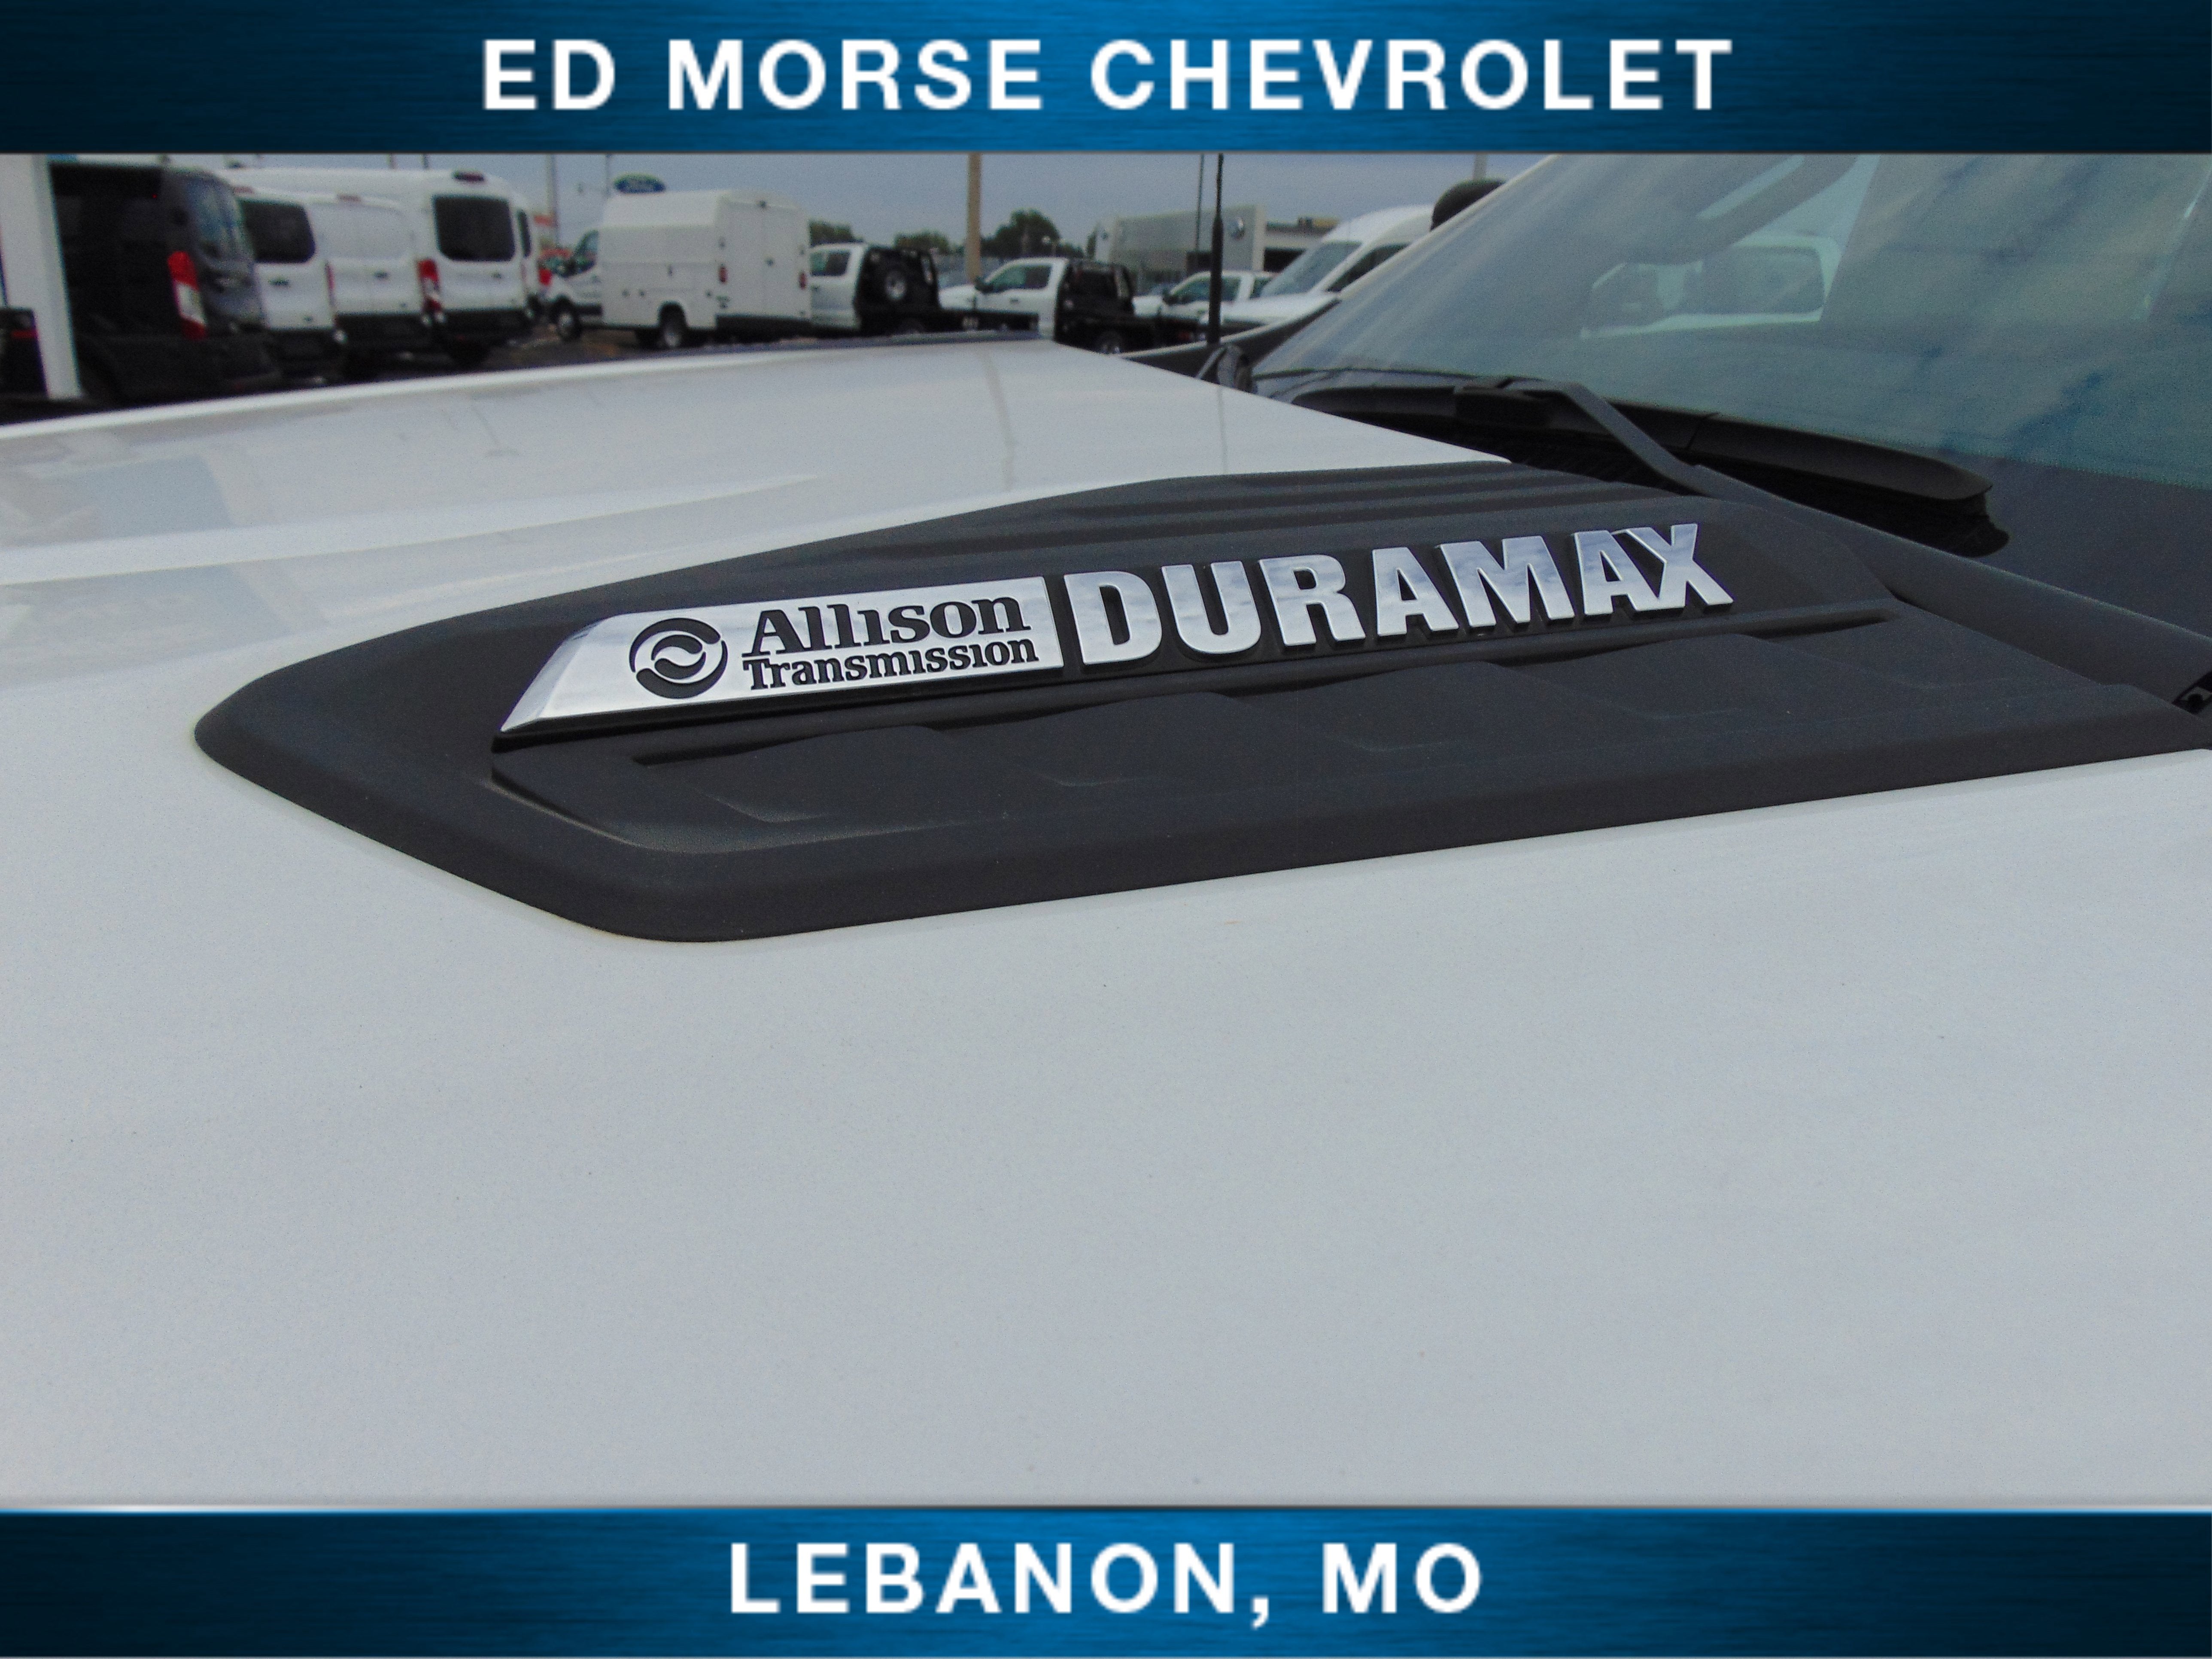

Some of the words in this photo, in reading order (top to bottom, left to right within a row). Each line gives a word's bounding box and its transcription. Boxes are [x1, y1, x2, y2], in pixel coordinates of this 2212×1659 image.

[1063, 523, 1734, 665] DURAMAX
[741, 596, 1031, 657] Allison
[743, 638, 1040, 690] Transmission
